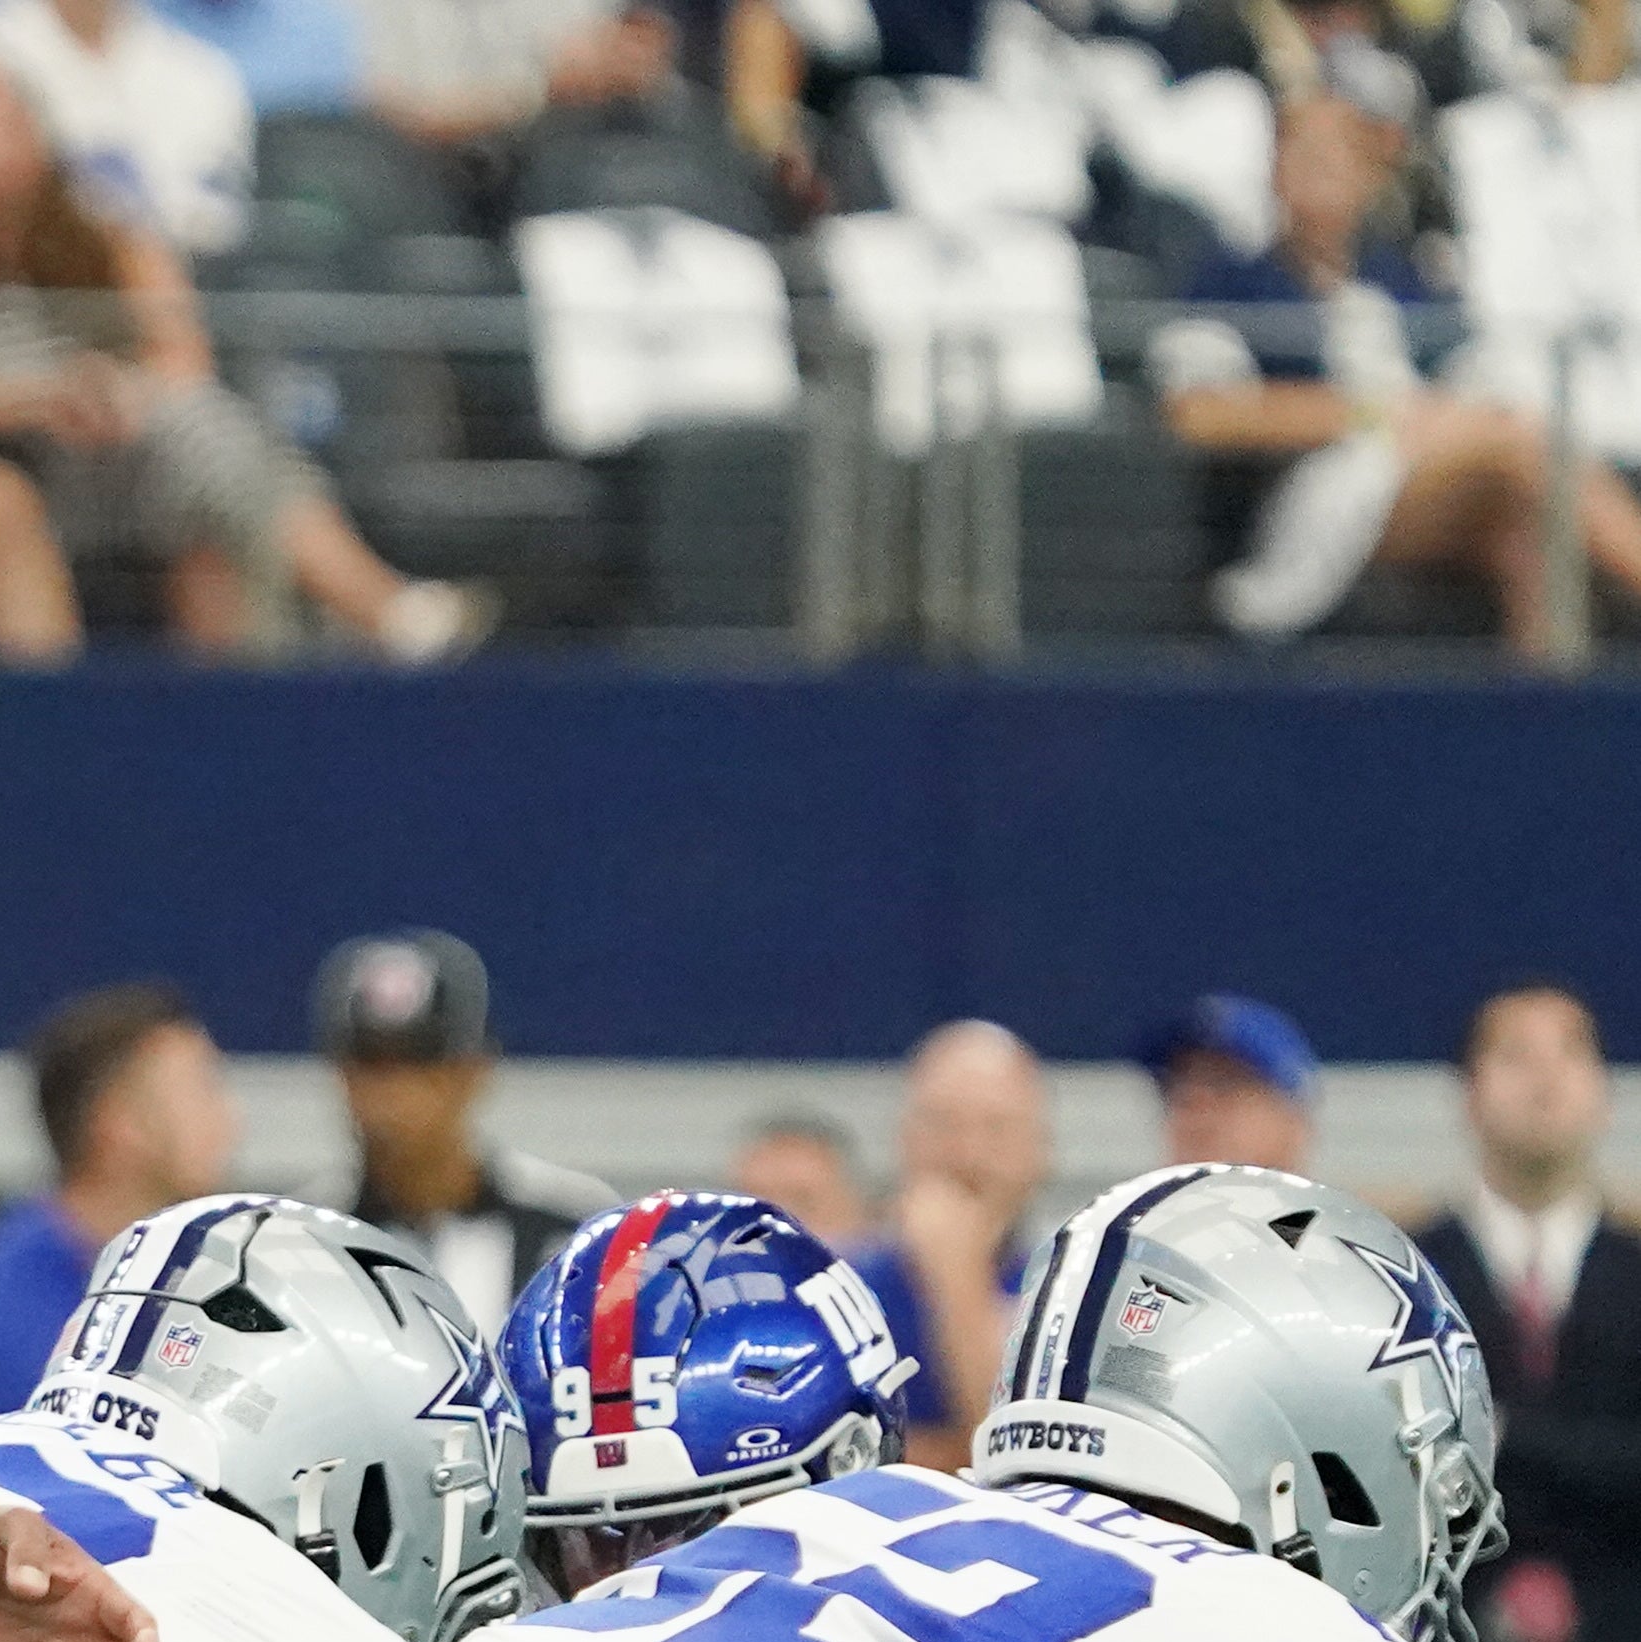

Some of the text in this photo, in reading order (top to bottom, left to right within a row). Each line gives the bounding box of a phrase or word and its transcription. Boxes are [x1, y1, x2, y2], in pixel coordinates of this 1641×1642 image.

[1122, 1306, 1157, 1331] NFL
[160, 1340, 192, 1364] NFL
[987, 1419, 1106, 1459] COWBOYS
[725, 1442, 792, 1463] OAKLEY
